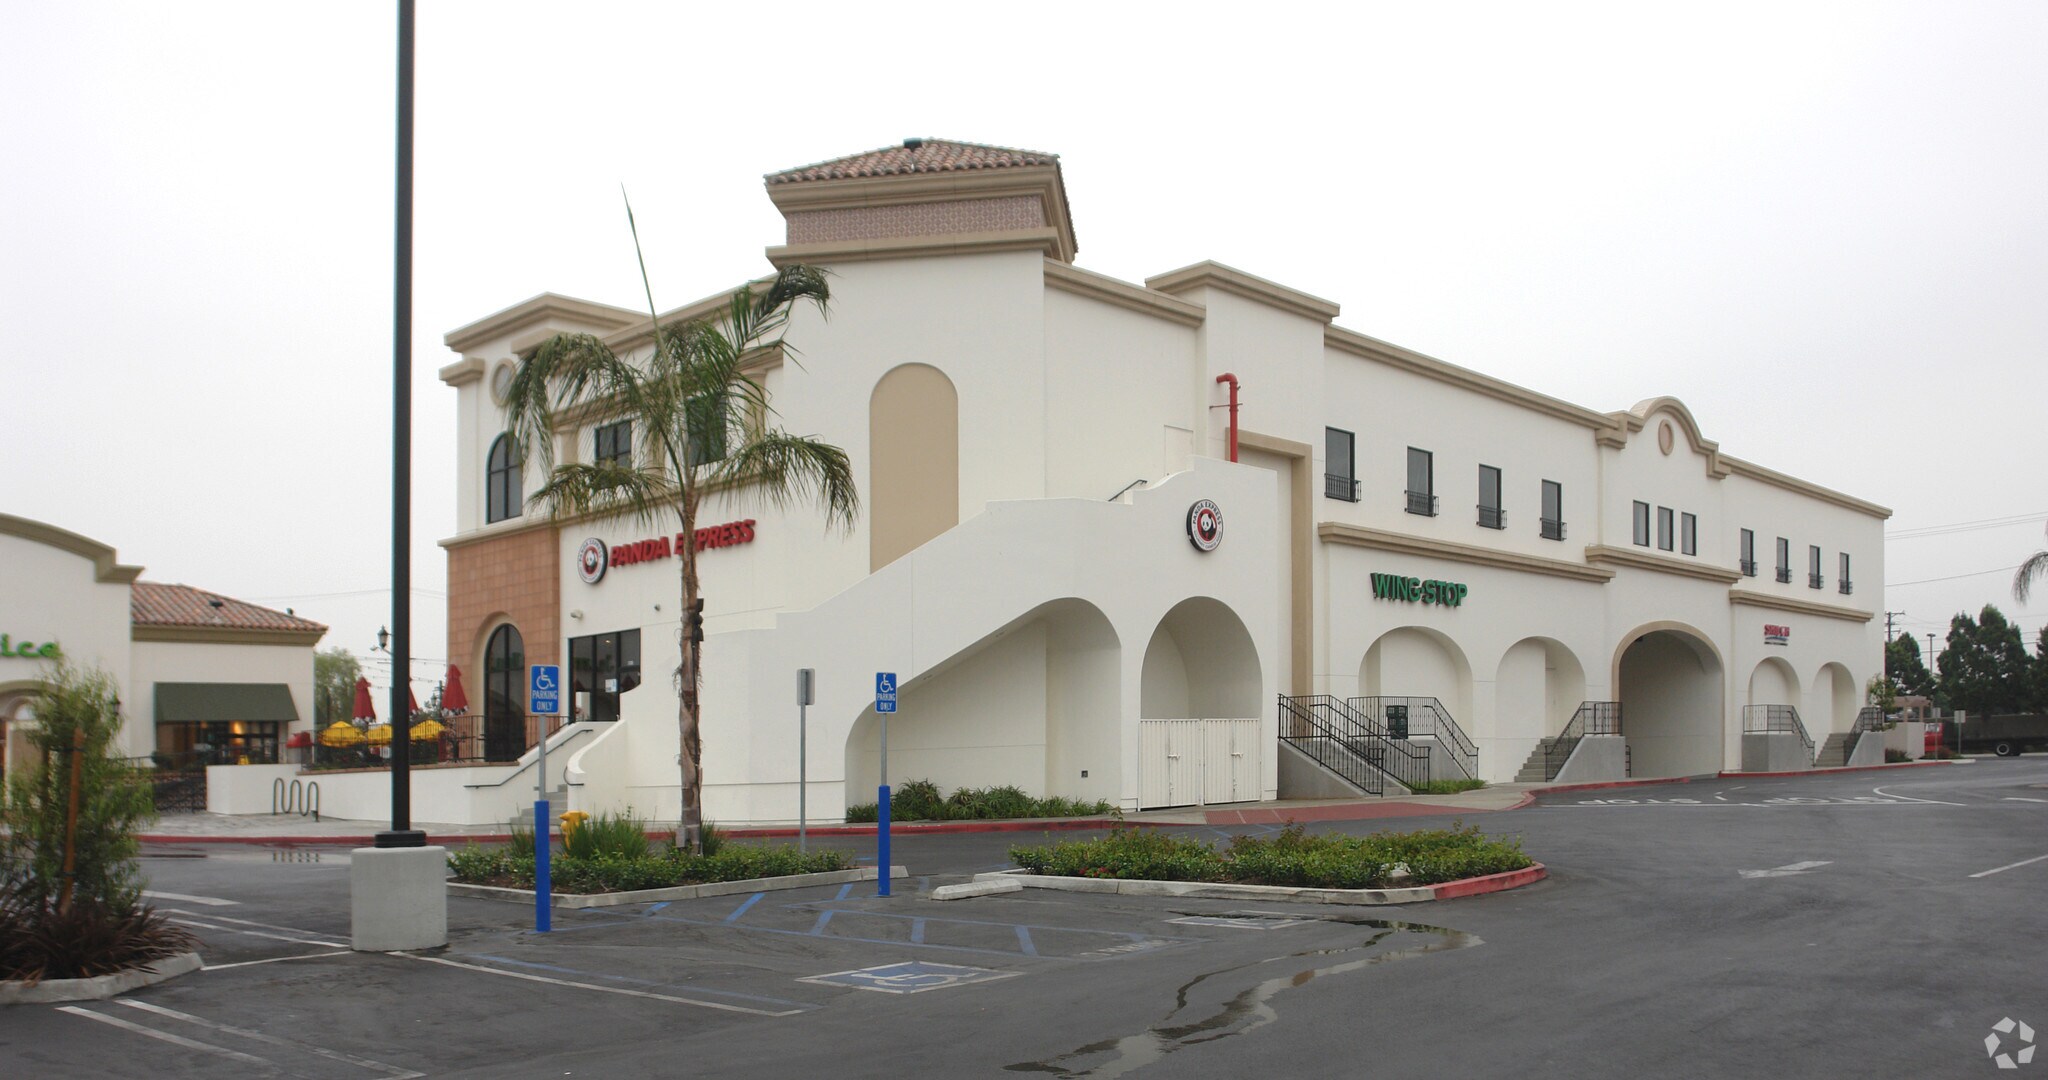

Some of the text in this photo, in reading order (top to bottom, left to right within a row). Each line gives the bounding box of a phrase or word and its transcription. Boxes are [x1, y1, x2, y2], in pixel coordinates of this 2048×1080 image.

[609, 536, 671, 567] PANDA
[674, 519, 756, 555] EPRESS
[532, 690, 558, 699] PARKING
[537, 701, 553, 710] ONLY
[880, 702, 893, 710] ONLY
